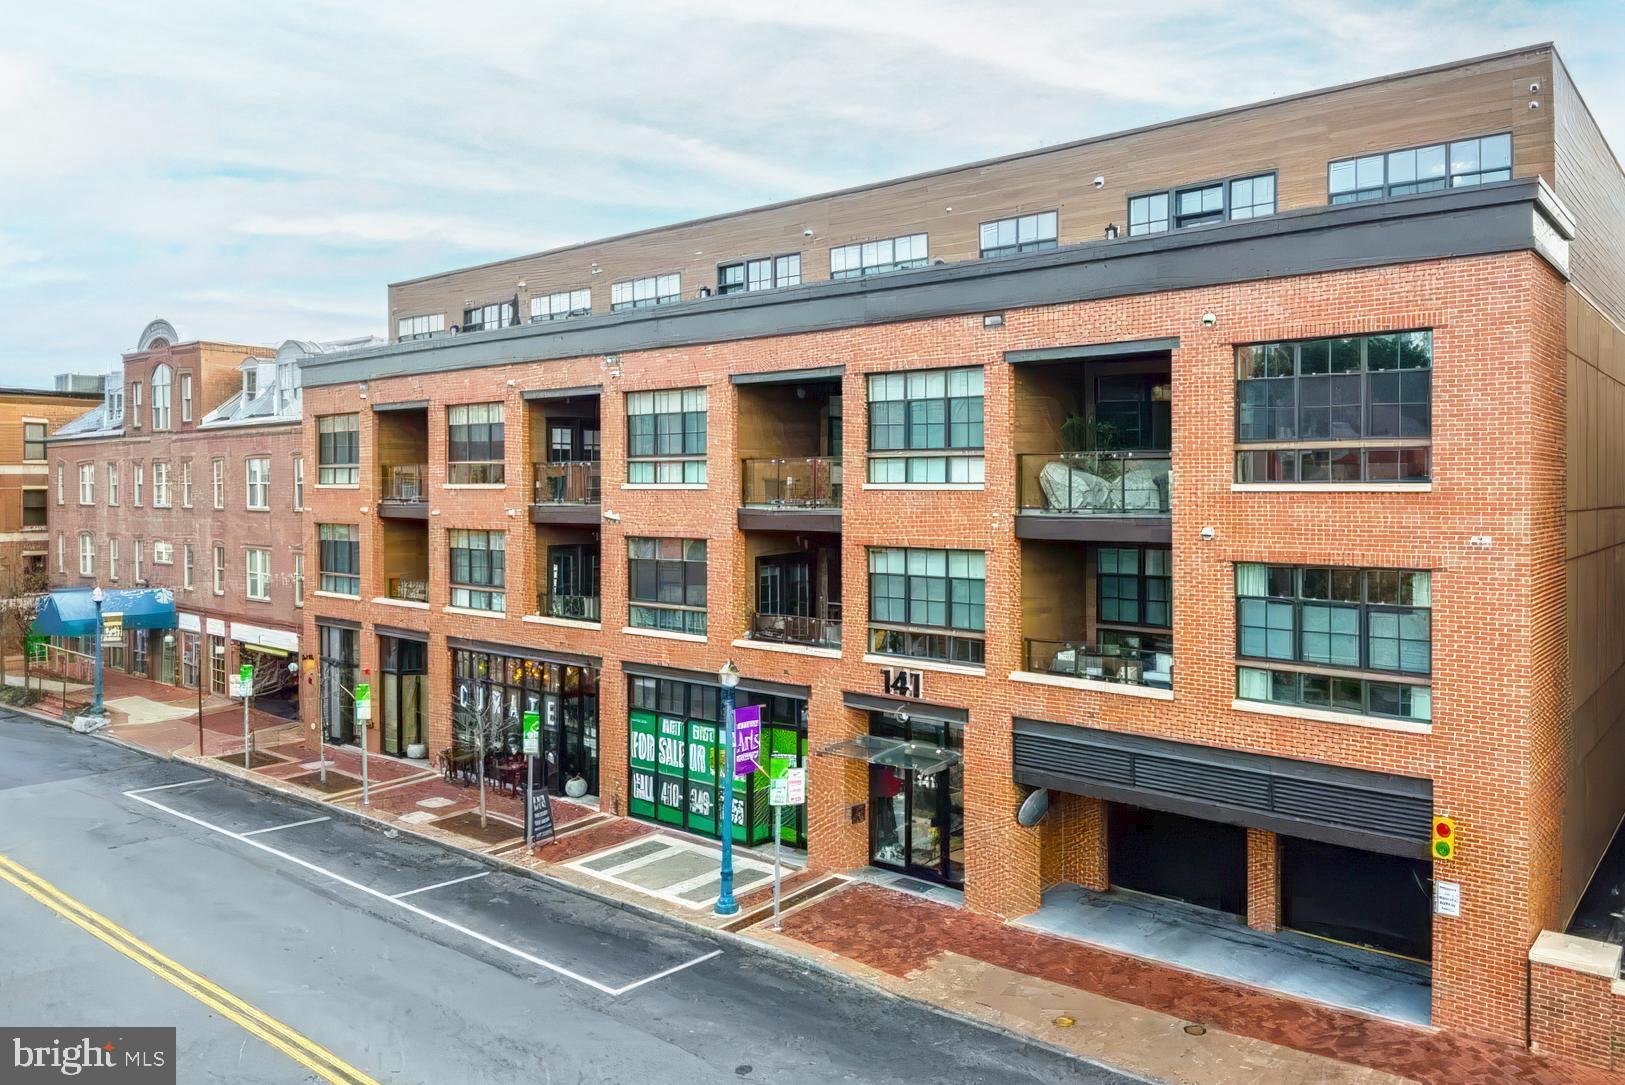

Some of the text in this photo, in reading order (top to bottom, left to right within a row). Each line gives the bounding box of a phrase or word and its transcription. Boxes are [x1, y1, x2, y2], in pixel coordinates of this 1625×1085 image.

[880, 668, 921, 699] 141
[631, 731, 656, 762] FOR
[658, 737, 685, 769] SALE
[736, 730, 760, 754] Arts
